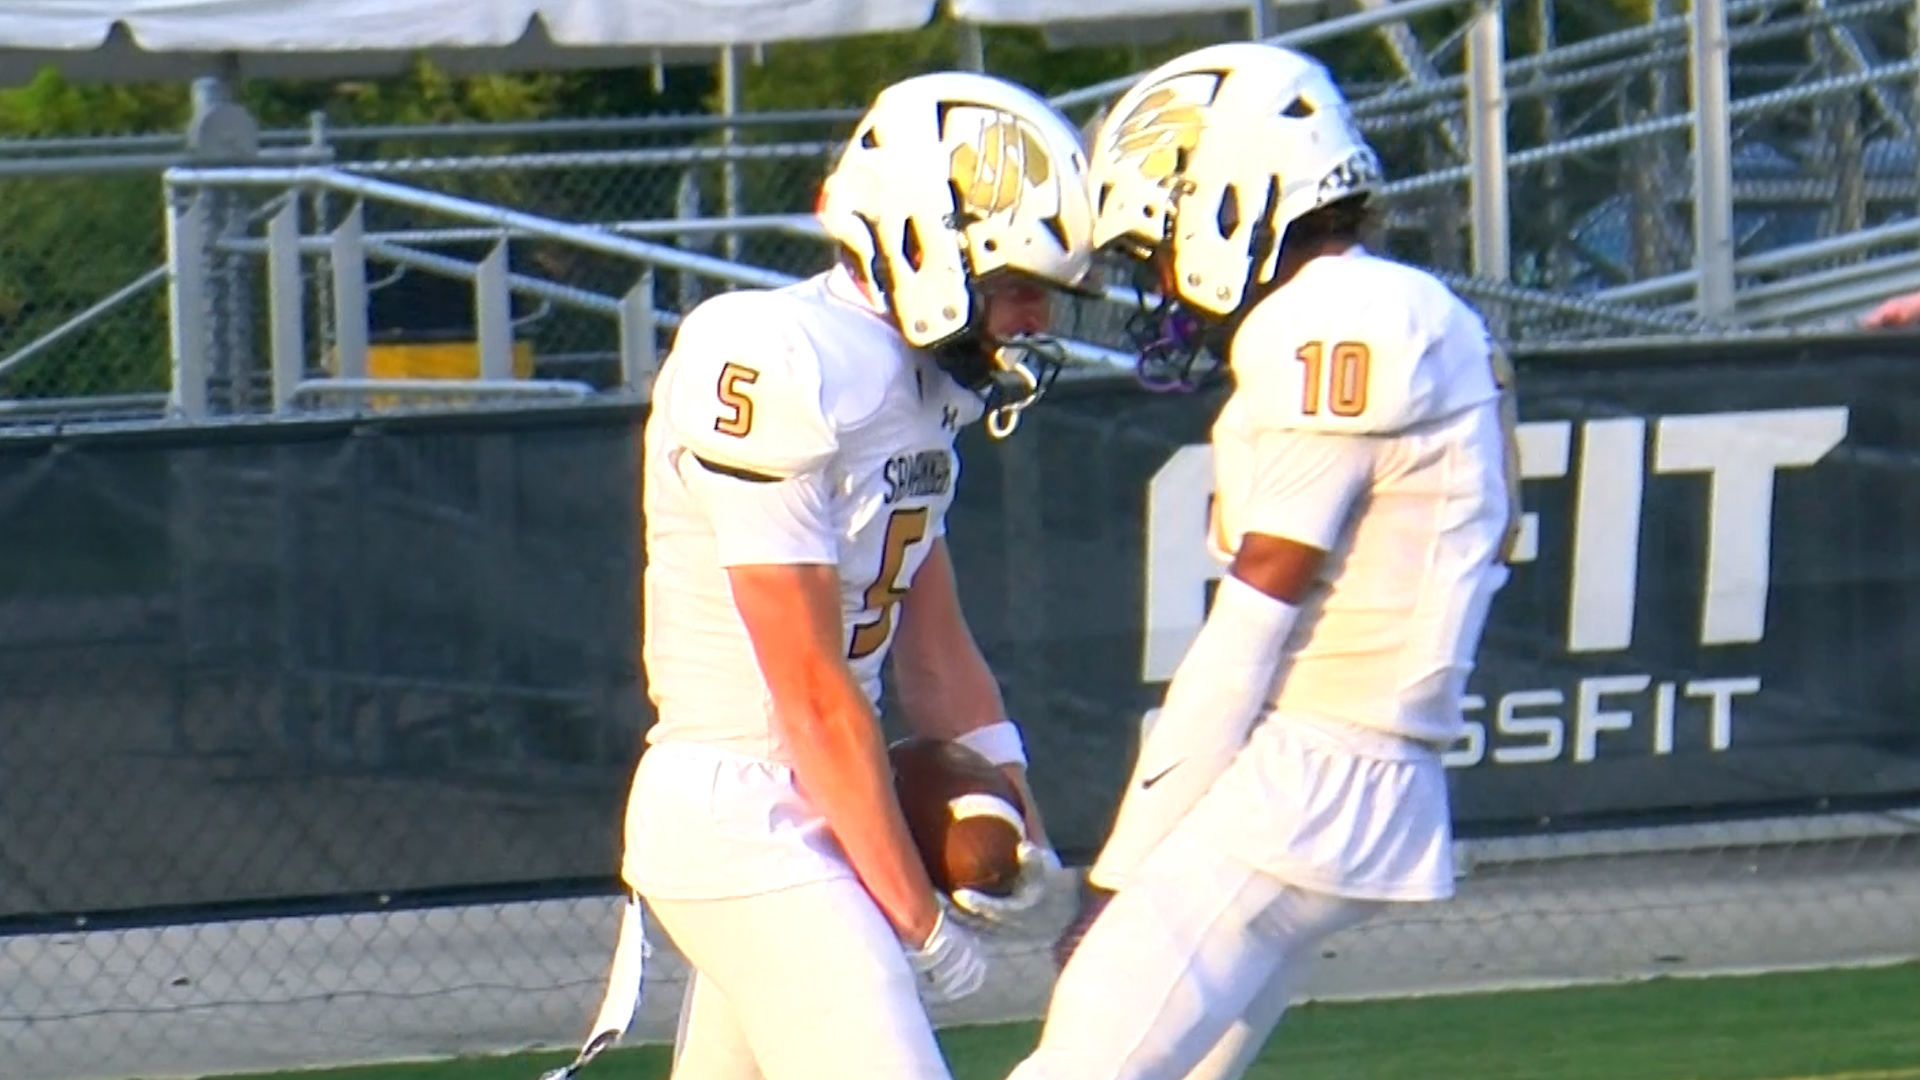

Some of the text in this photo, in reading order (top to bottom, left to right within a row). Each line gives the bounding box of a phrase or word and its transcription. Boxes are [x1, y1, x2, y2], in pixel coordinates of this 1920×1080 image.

[714, 361, 760, 439] 5
[1295, 340, 1370, 417] 10
[848, 505, 929, 659] 5
